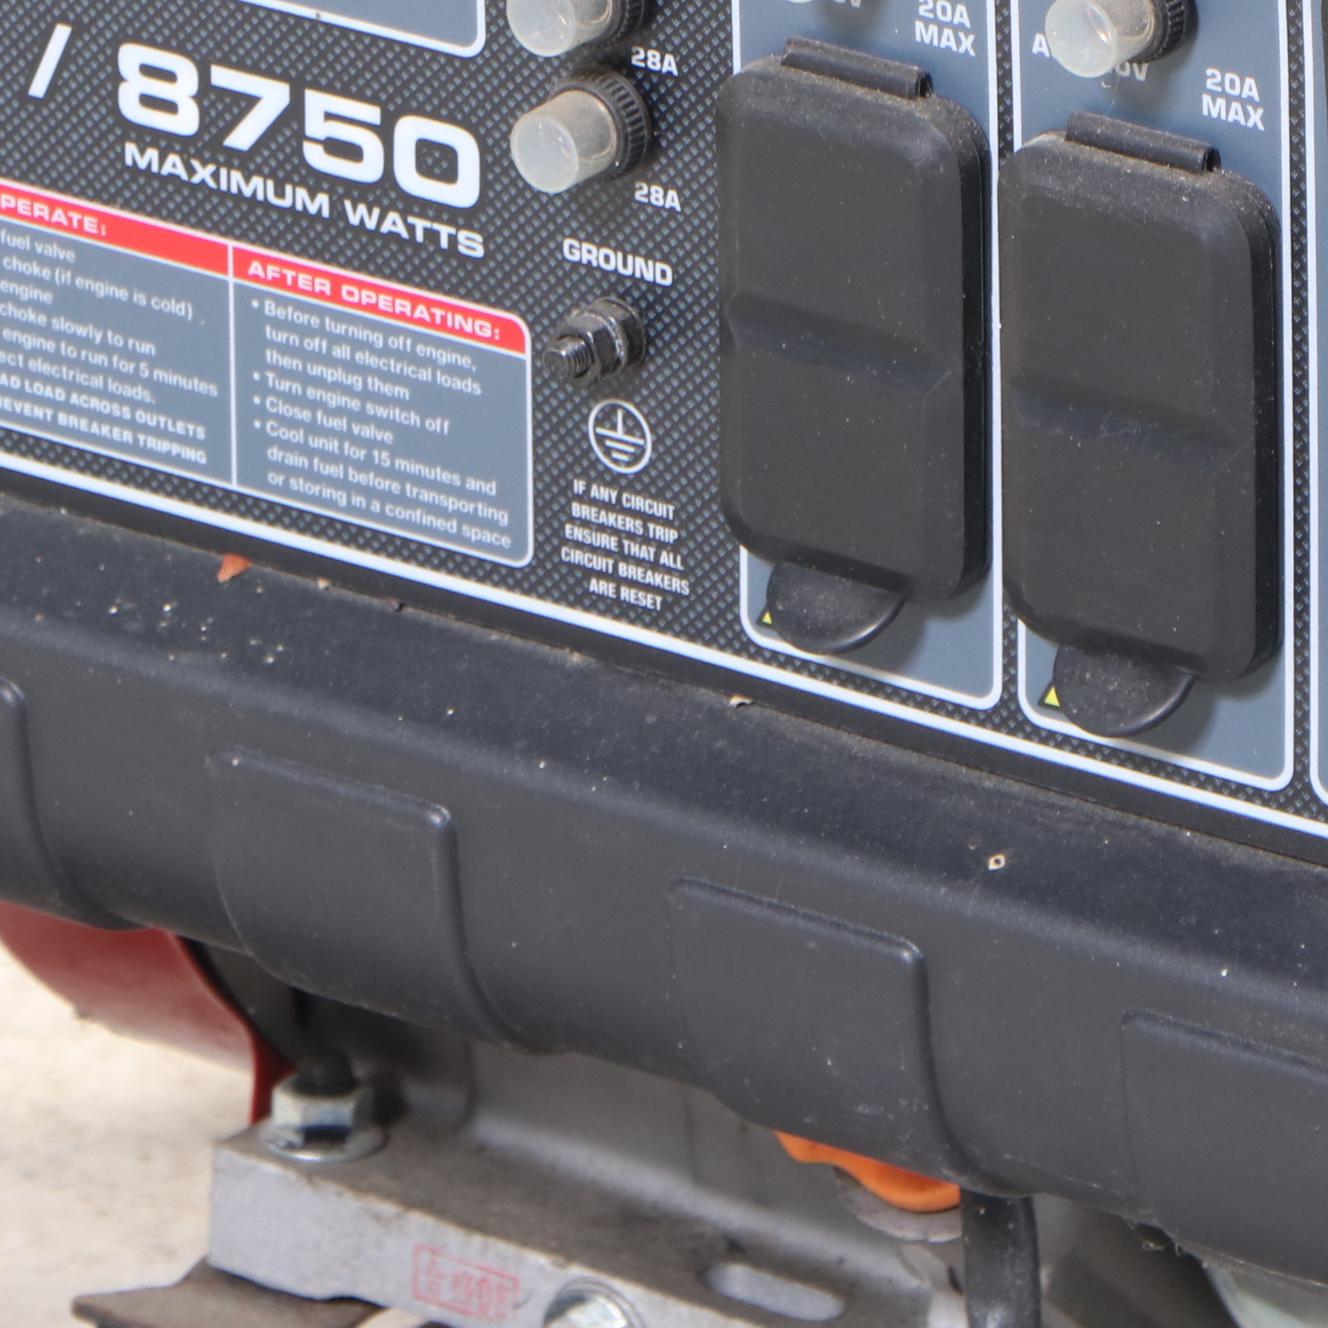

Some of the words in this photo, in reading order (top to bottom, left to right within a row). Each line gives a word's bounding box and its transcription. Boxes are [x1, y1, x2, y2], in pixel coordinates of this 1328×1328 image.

[632, 46, 678, 76] 28A
[915, 21, 976, 57] MAX
[1205, 68, 1260, 102] 20A
[27, 23, 71, 99] /
[117, 42, 480, 208] 8750
[1202, 94, 1264, 131] MAX
[124, 142, 330, 219] MAXIMUM
[344, 200, 485, 259] WATTS
[635, 181, 681, 212] 28A
[1, 230, 30, 251] fuel
[35, 241, 76, 263] valve
[563, 237, 672, 287] GROUND
[248, 260, 331, 296] AFTER
[341, 285, 500, 340] OPERATING:
[28, 355, 103, 390] electrical
[107, 378, 156, 405] loads.
[25, 378, 66, 402] LOAD
[69, 392, 131, 420] ACROSS
[135, 409, 206, 440] OUTLETS
[266, 397, 312, 423] Close
[316, 410, 347, 431] fuel
[352, 422, 394, 444] valve
[58, 411, 133, 445] BREAKER
[137, 434, 207, 464] TRIPPING
[572, 502, 643, 536] BREAKERS
[648, 522, 678, 544] TRIP
[574, 479, 587, 495] IF
[590, 484, 618, 504] ANY
[622, 492, 675, 521] CIRCUIT
[565, 523, 618, 552] ENSURE
[623, 540, 656, 562] THAT
[660, 553, 684, 571] ALL
[561, 547, 614, 574] CIRCUIT
[619, 563, 690, 595] BREAKERS
[589, 578, 617, 598] ARE
[621, 587, 663, 611] RESET
